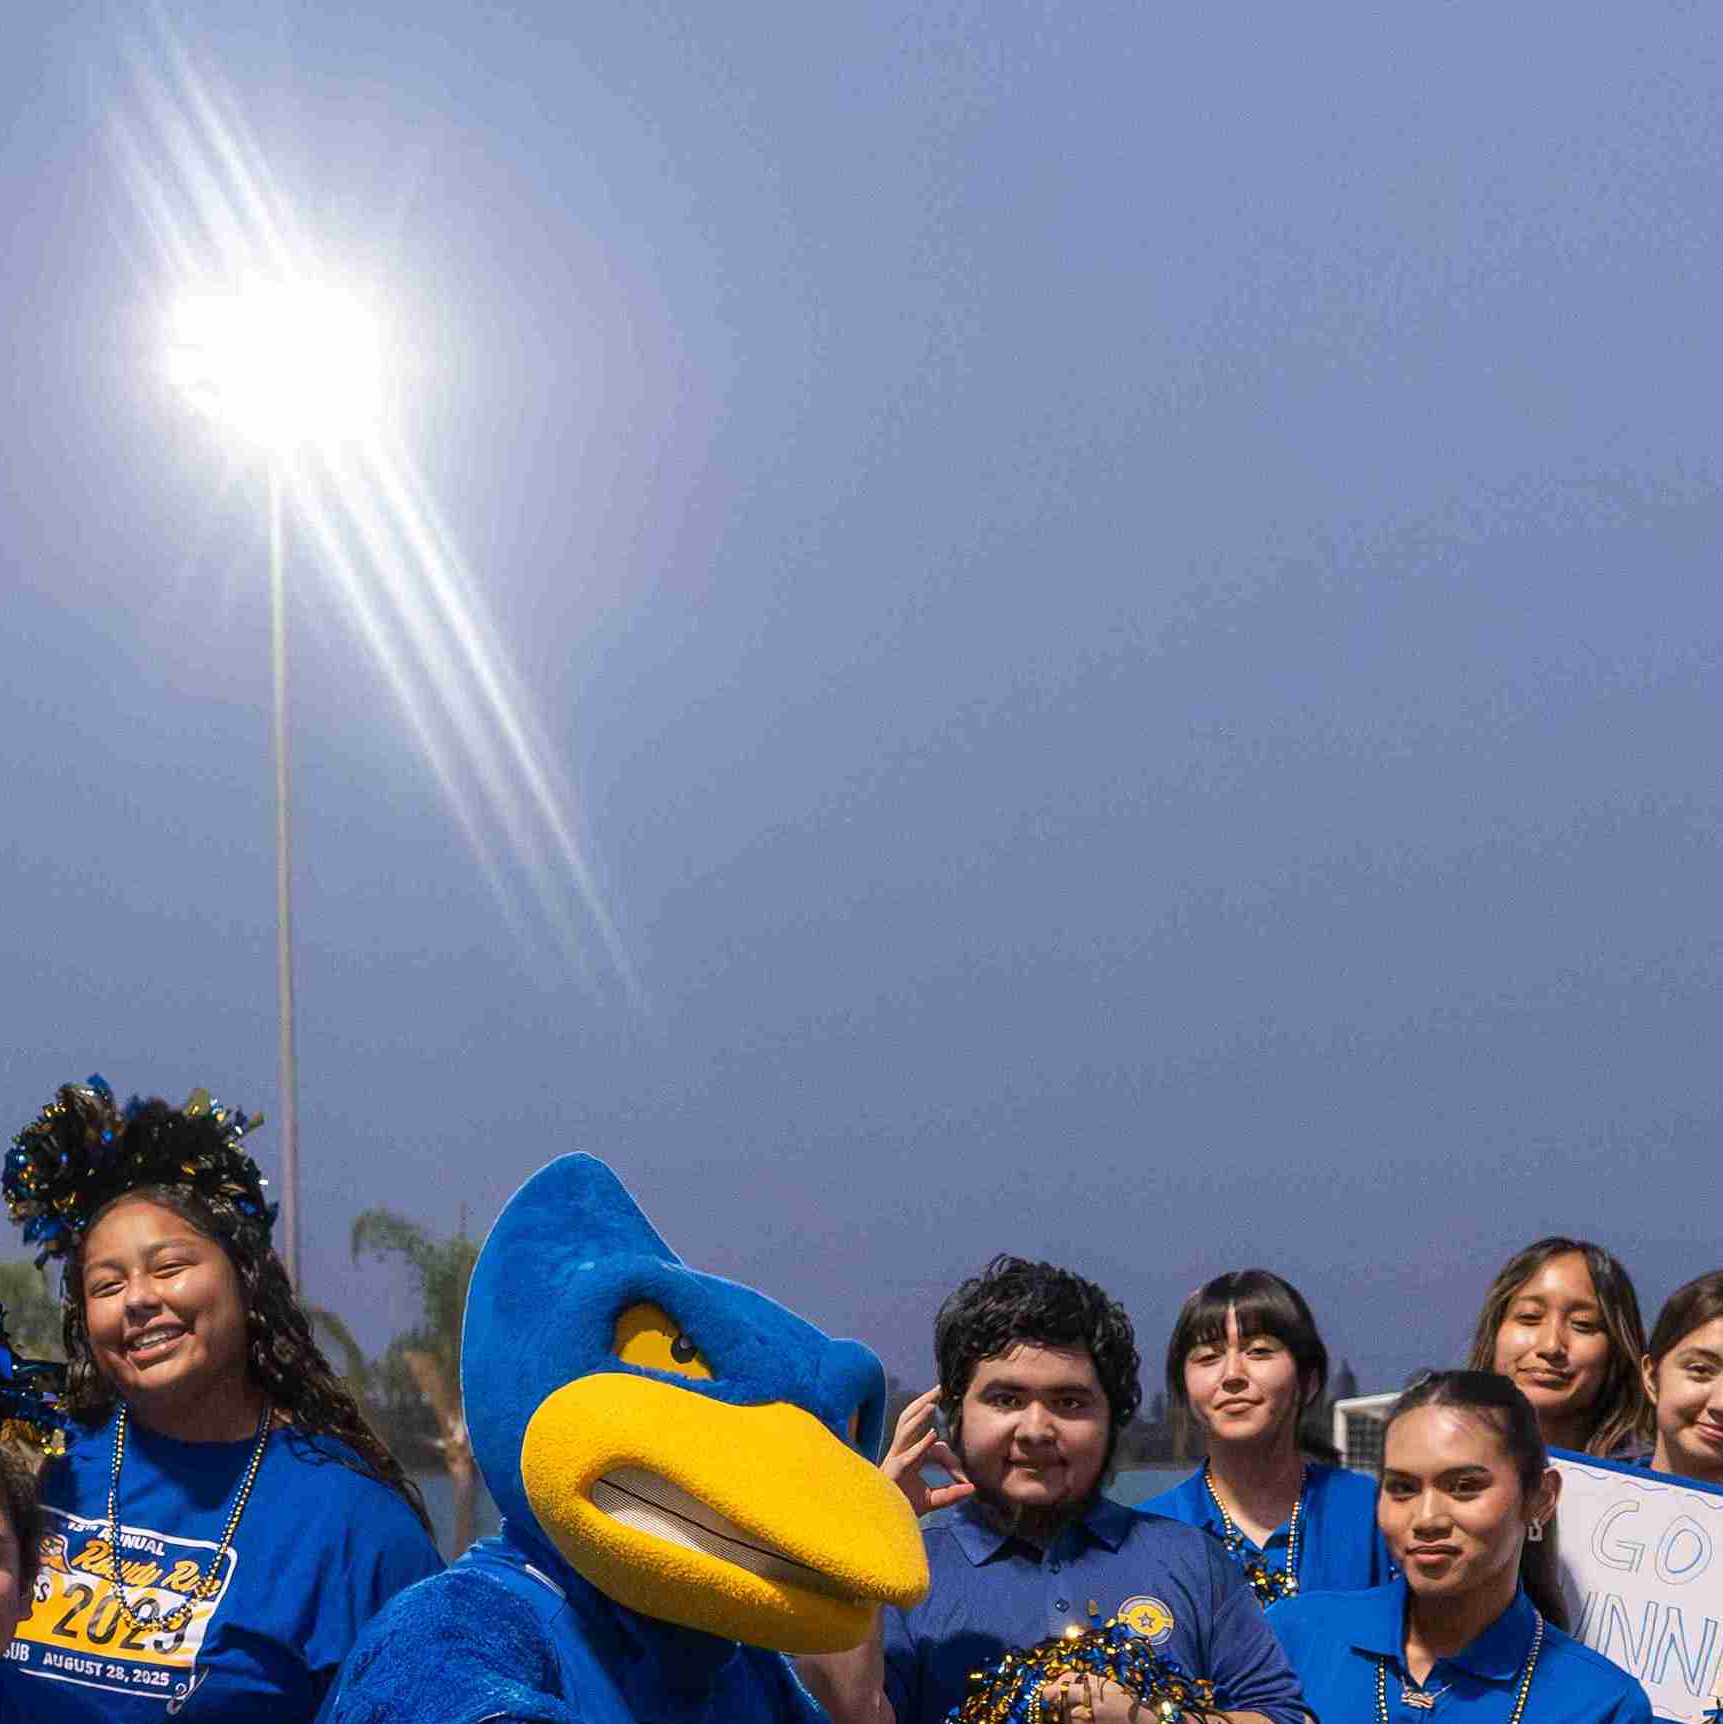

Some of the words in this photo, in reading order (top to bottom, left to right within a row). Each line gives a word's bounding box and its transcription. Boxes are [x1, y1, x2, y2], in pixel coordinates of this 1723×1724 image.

[97, 1526, 166, 1557] ANUAL
[1591, 1499, 1714, 1586] GO
[42, 1650, 103, 1677] AUGUST
[132, 1668, 171, 1687] 2025
